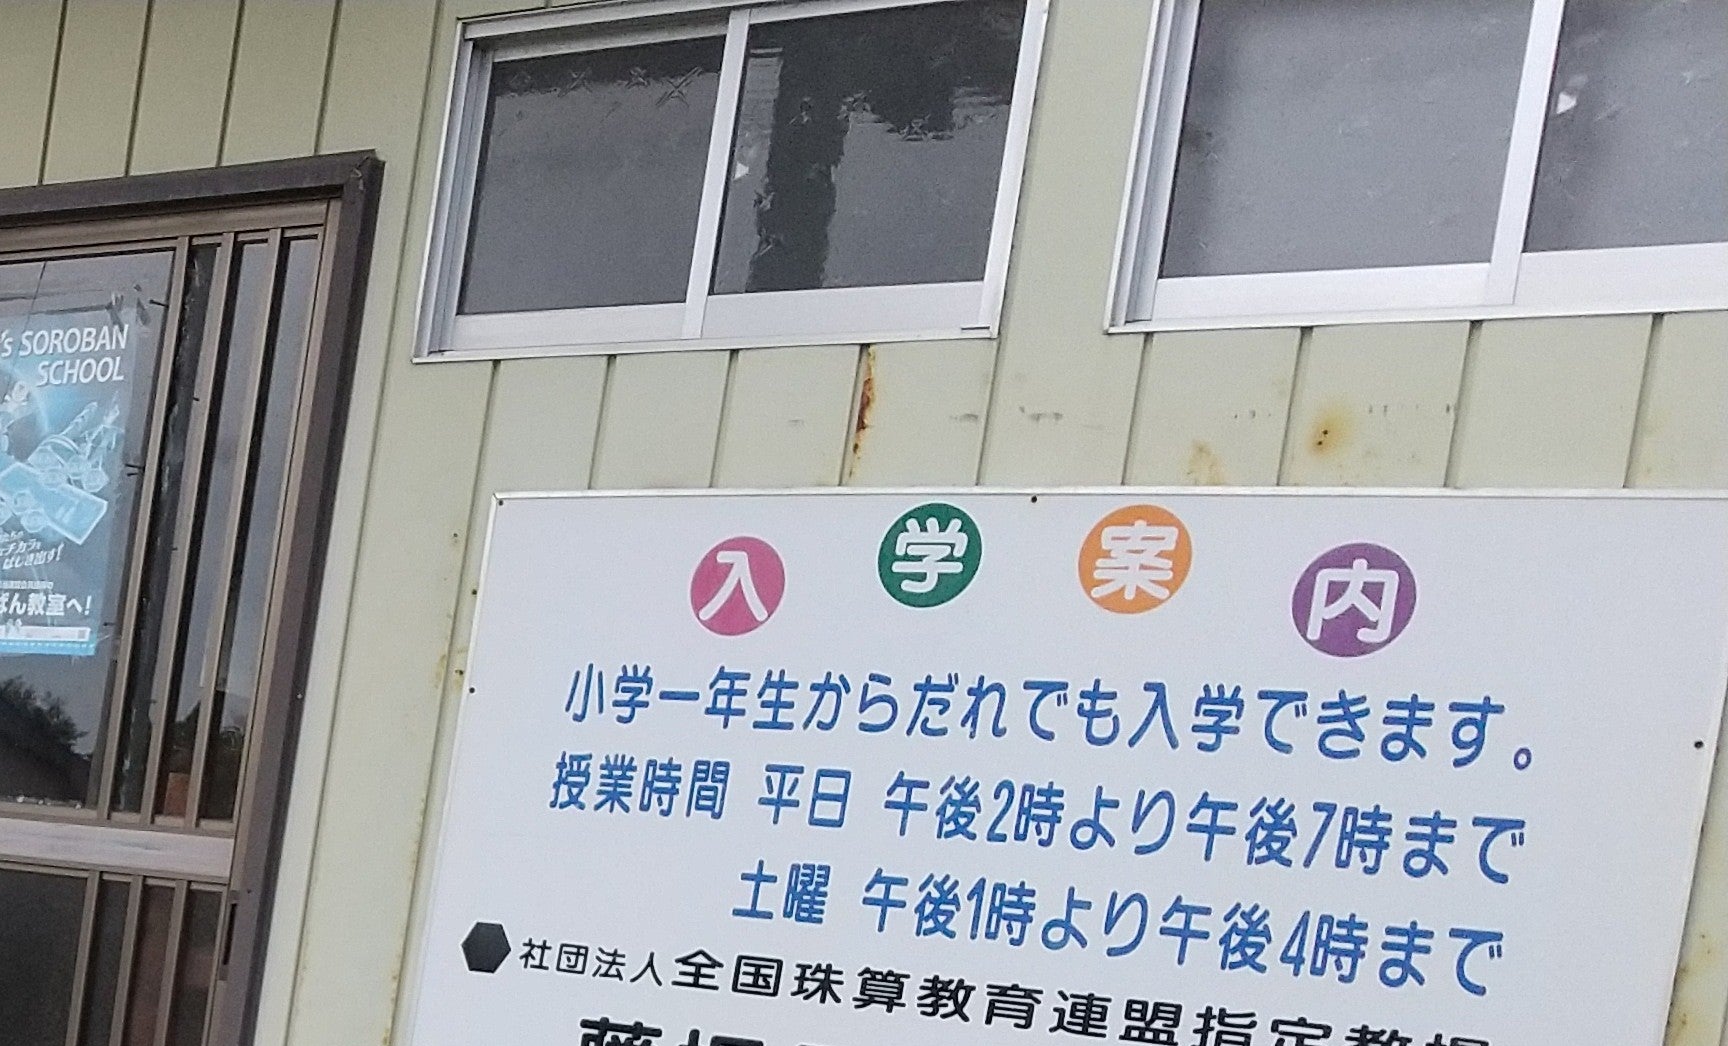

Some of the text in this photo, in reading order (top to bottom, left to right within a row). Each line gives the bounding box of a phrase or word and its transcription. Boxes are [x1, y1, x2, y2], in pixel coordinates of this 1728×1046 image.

[19, 324, 129, 357] SOROBAN
[36, 356, 124, 387] SCHOOL
[564, 663, 1533, 772] 小学一年生からだれでも入学できます。
[549, 751, 1527, 885] 授業時間 平日 午後2時より午後7時まで
[731, 859, 1504, 996] 土曜 午後1時より午後4時まで
